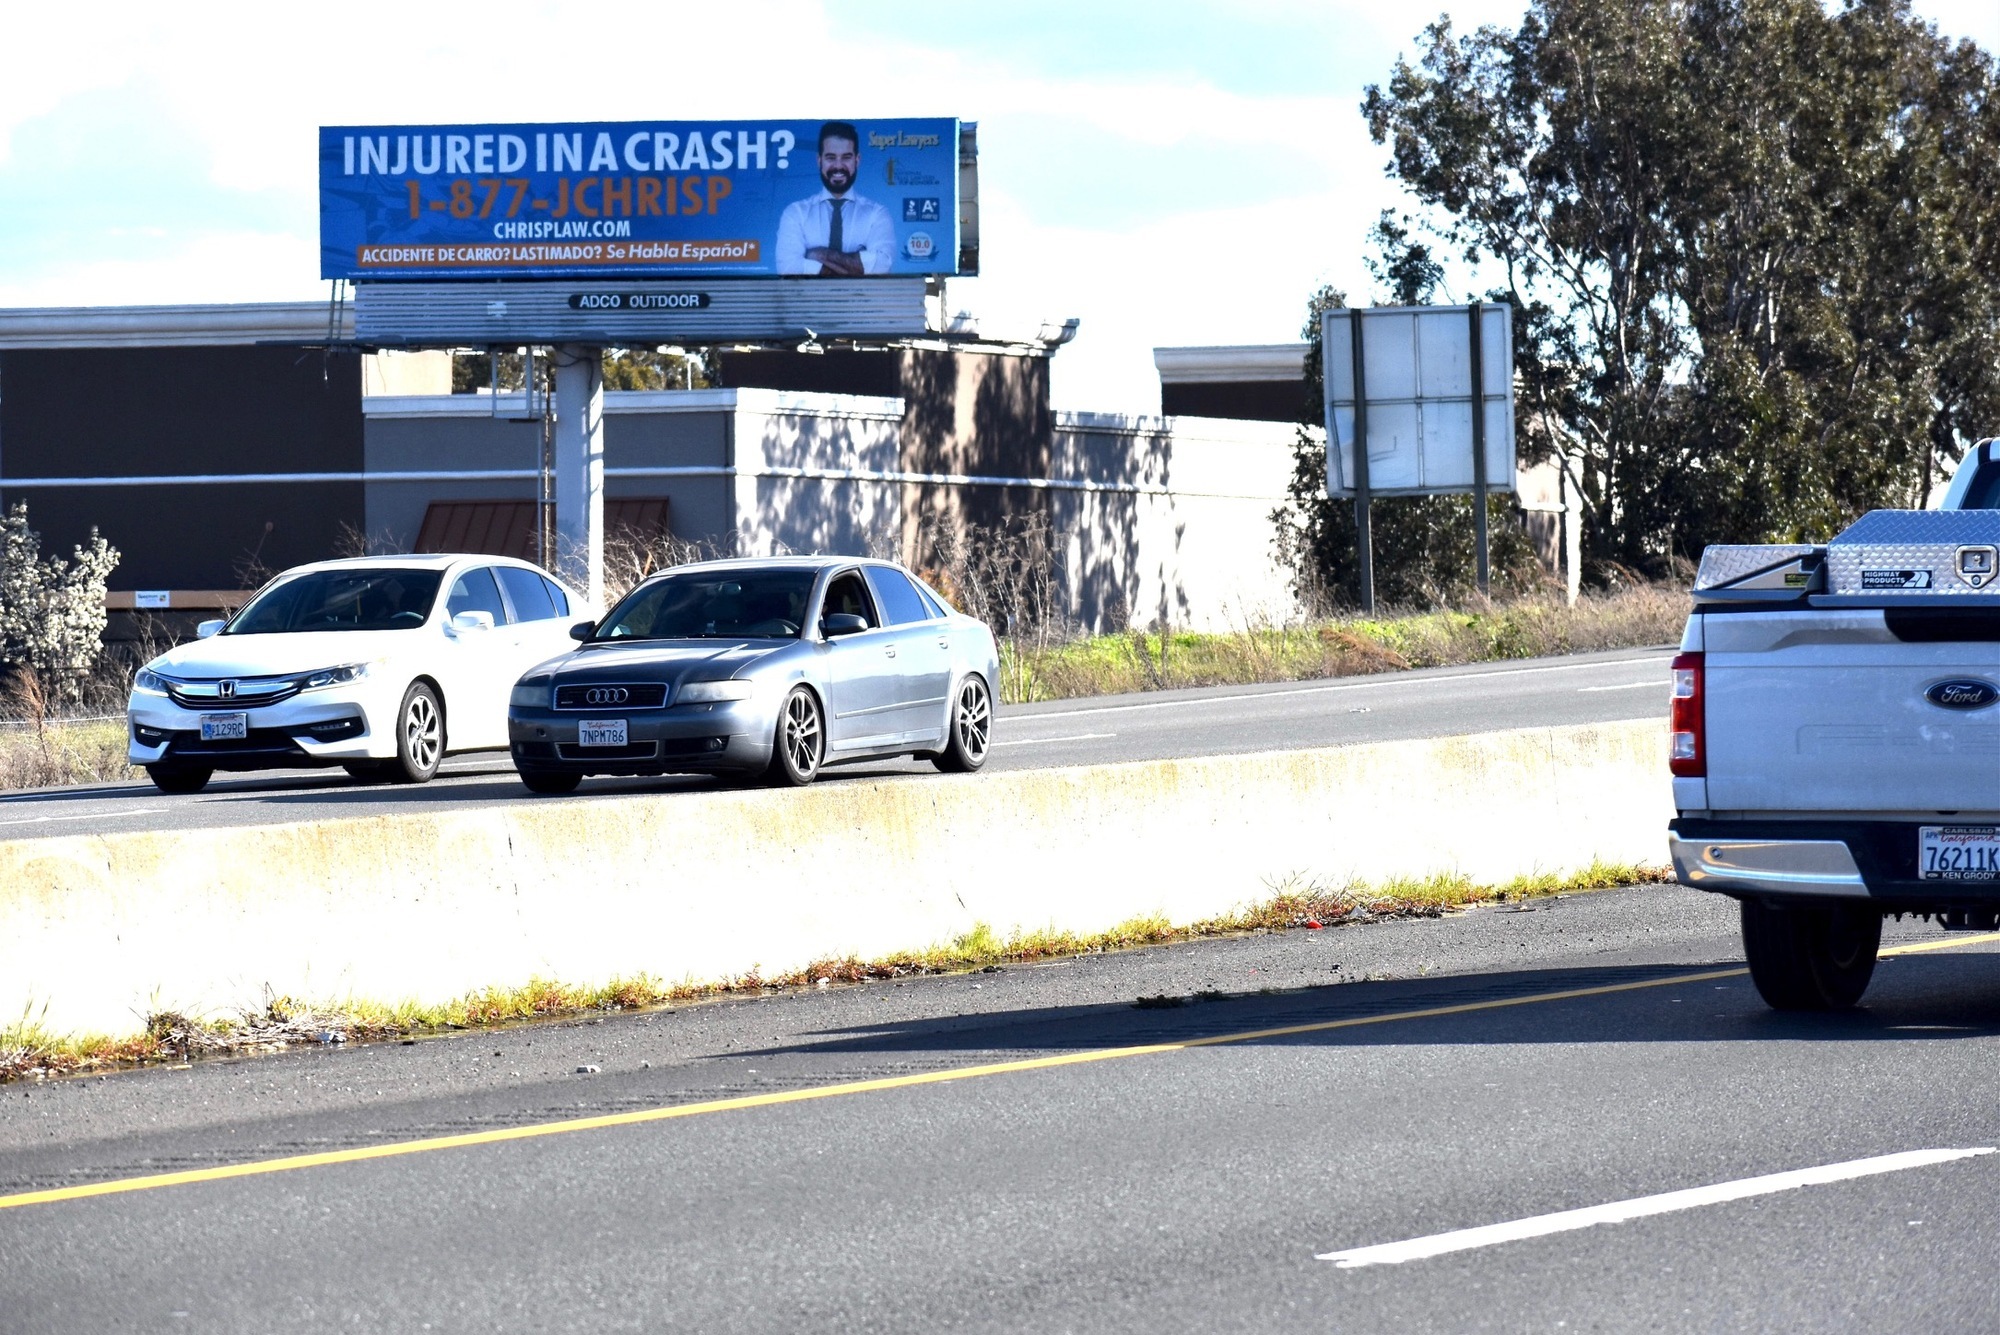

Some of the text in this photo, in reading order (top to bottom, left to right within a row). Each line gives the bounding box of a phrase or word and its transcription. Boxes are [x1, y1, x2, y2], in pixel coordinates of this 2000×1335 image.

[869, 130, 940, 151] Super Lawyers
[344, 129, 796, 175] INJURED IN A CRASH?
[405, 176, 733, 219] 1-877-JCHRISP
[494, 220, 631, 240] CHRISPLAW.COM
[362, 248, 435, 263] ACCIDENTE
[438, 248, 456, 262] DE
[457, 247, 510, 262] CARRO?
[512, 245, 602, 261] LASTIMADO?
[606, 244, 626, 259] Se
[629, 243, 679, 259] Habla
[911, 240, 930, 249] 10.0
[580, 294, 700, 308] ADCO OUTDOOR
[1941, 685, 1983, 703] Ford
[581, 729, 625, 744] 7NPM786
[1941, 833, 2000, 846] California
[1926, 846, 1999, 871] 76211K
[1942, 871, 1961, 879] KEN
[1963, 871, 1996, 879] GRODY
